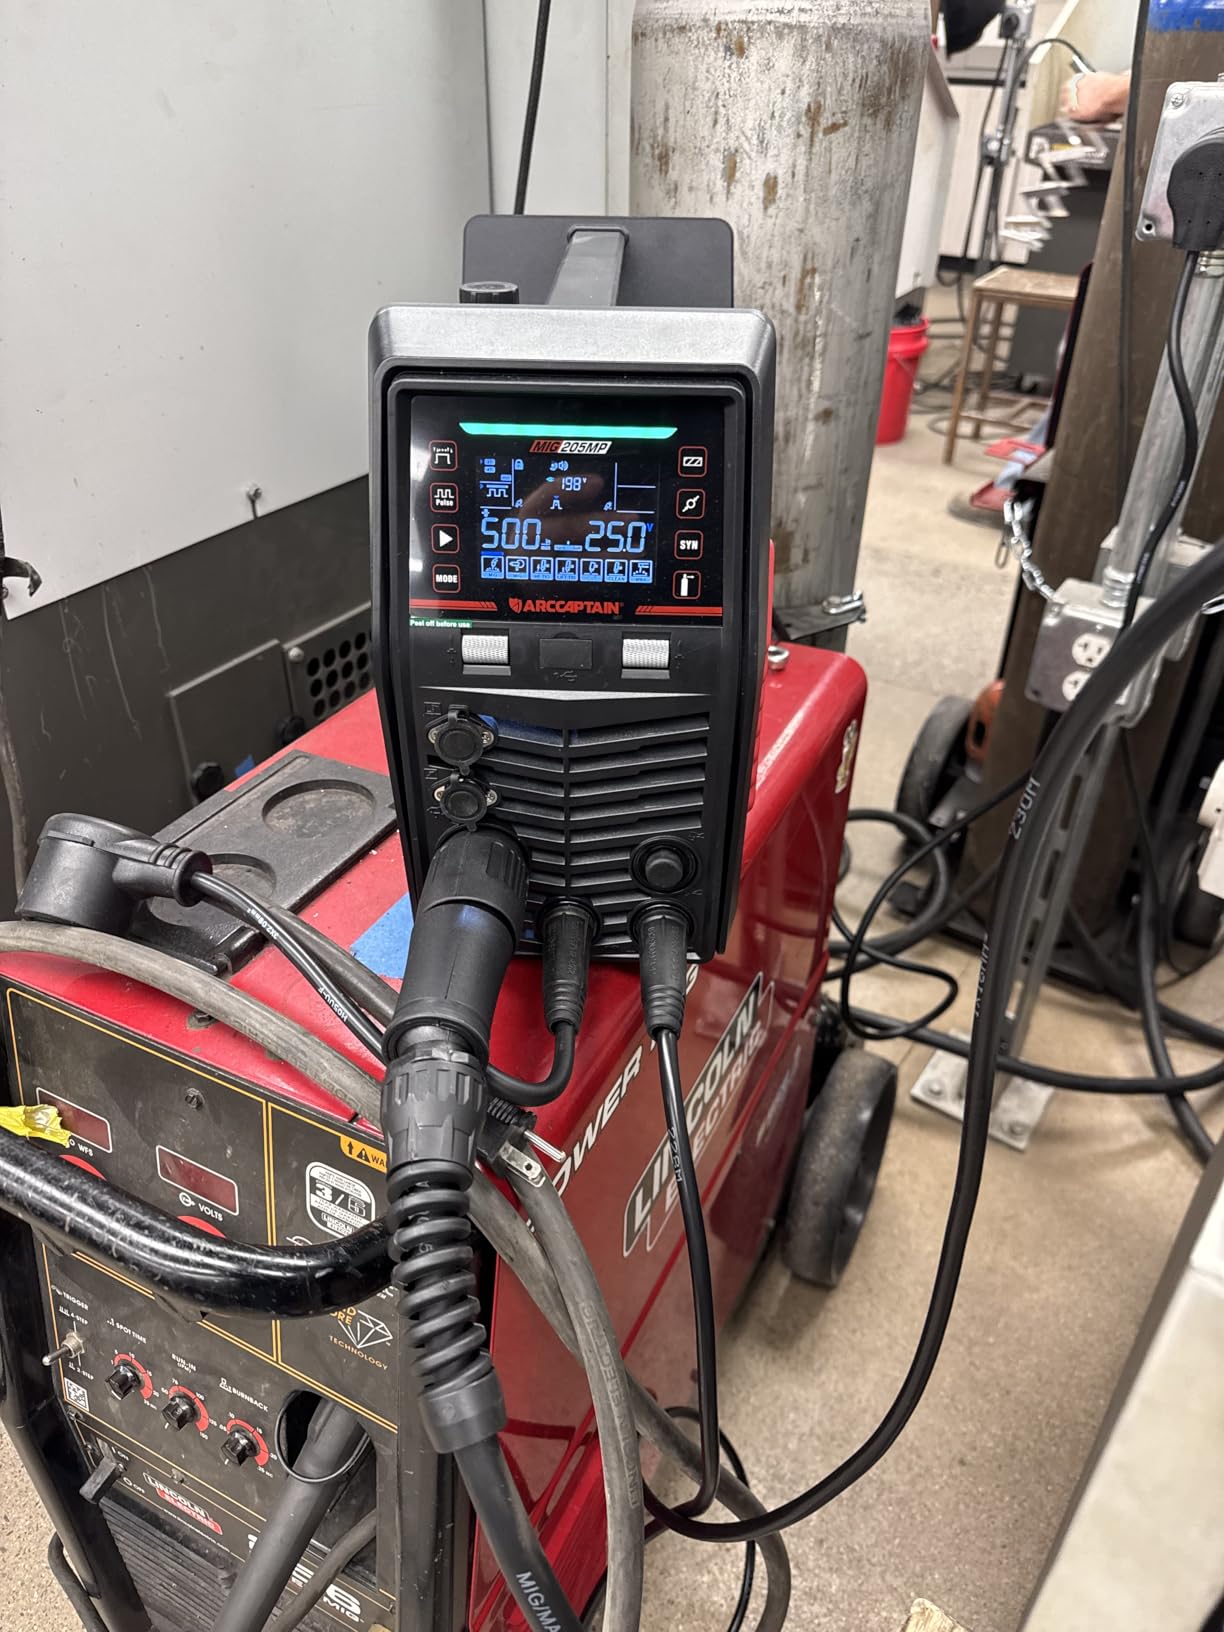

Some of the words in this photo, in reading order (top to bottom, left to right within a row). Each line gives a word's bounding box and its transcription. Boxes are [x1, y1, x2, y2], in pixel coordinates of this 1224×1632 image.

[533, 441, 561, 453] MIG
[561, 441, 608, 454] 205MP
[562, 477, 581, 491] 198
[435, 499, 454, 507] Pulse
[481, 517, 541, 549] 500
[585, 520, 647, 553] 25.0
[680, 540, 698, 550] SYN
[436, 574, 458, 583] MODE
[523, 600, 620, 614] ARCCAPTAIN
[410, 619, 424, 627] Peel
[436, 620, 457, 628] before
[77, 1143, 94, 1157] WFS
[198, 1203, 223, 1221] VOLTS
[63, 1291, 89, 1310] TRIGGER
[115, 1322, 131, 1335] SPOT
[132, 1331, 147, 1344] TIME
[329, 1335, 388, 1370] TECHNOLOGY
[172, 1353, 196, 1372] RUN-IN
[232, 1388, 268, 1412] BURNBACK
[148, 1476, 206, 1518] LINCOLN
[323, 1595, 360, 1622] MIG
